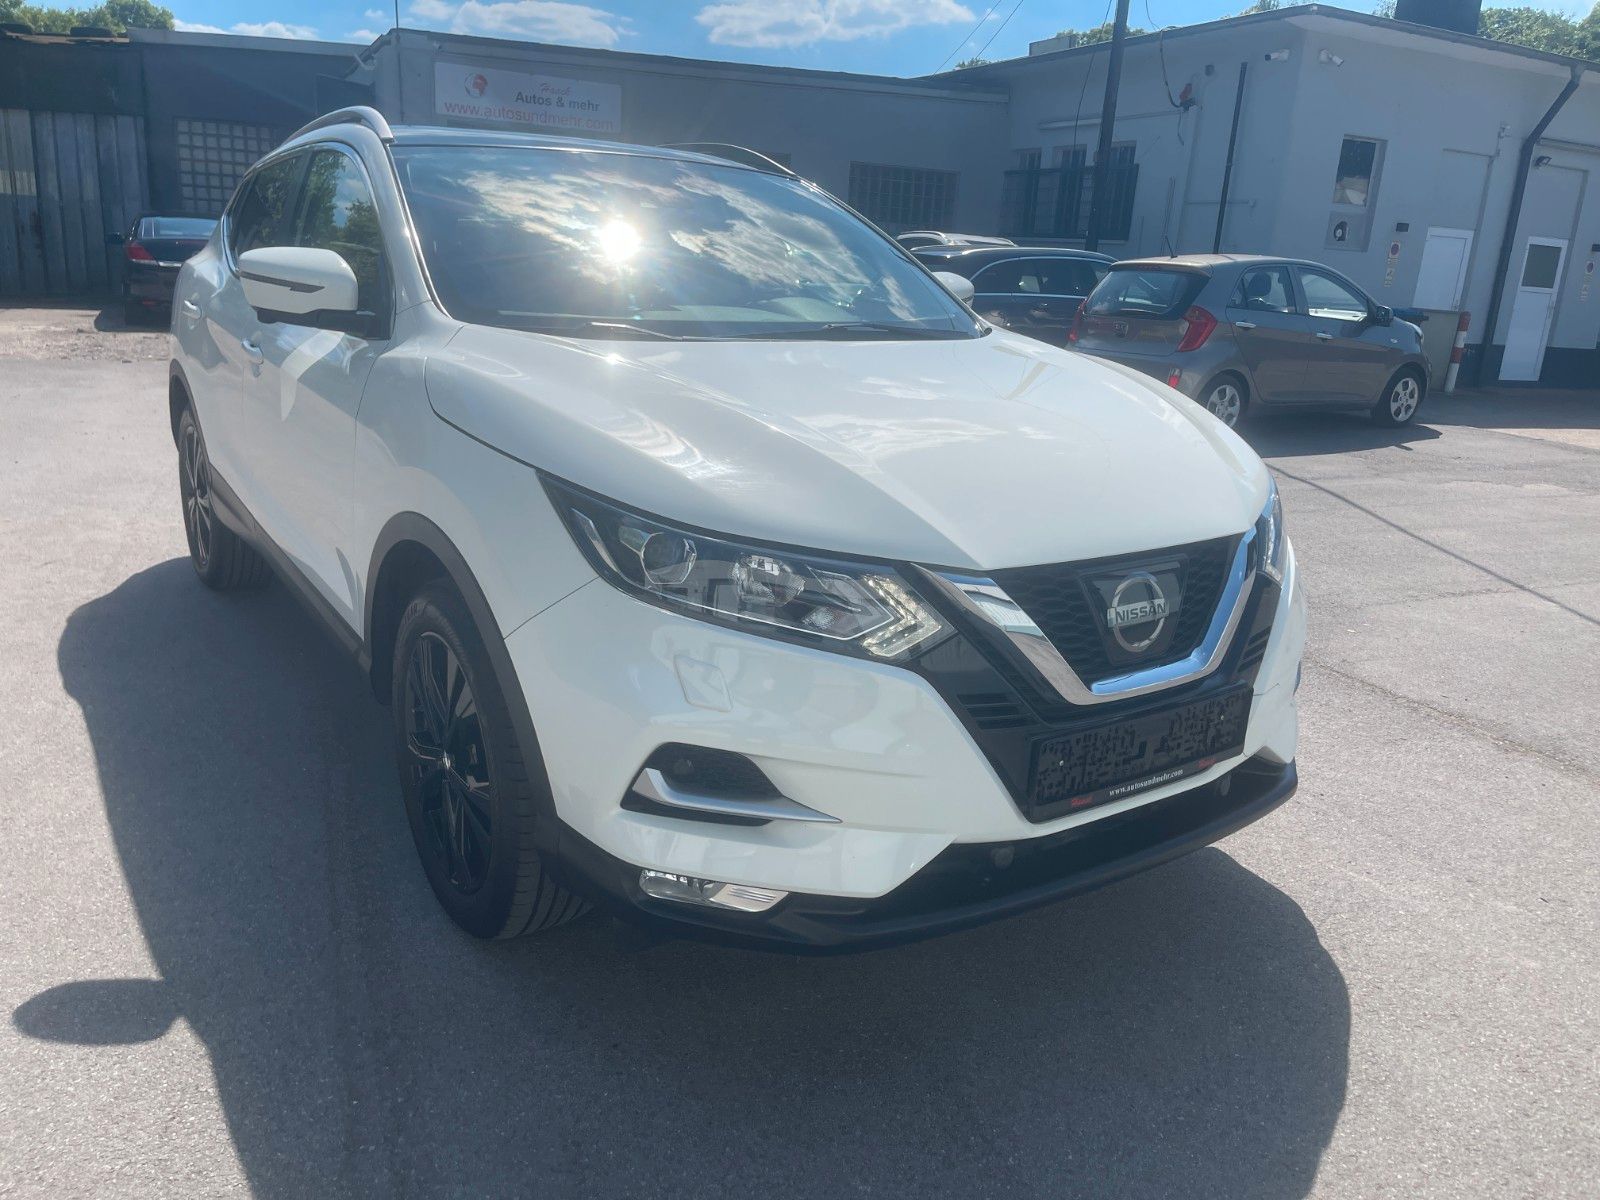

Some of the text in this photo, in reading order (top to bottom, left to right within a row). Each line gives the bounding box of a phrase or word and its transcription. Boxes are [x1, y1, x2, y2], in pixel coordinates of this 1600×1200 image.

[514, 91, 600, 112] Autos & mehr
[445, 102, 614, 131] www.autosundmehr.com
[1115, 603, 1167, 623] NISSAN
[1109, 769, 1183, 796] www.autosundmehr.com
